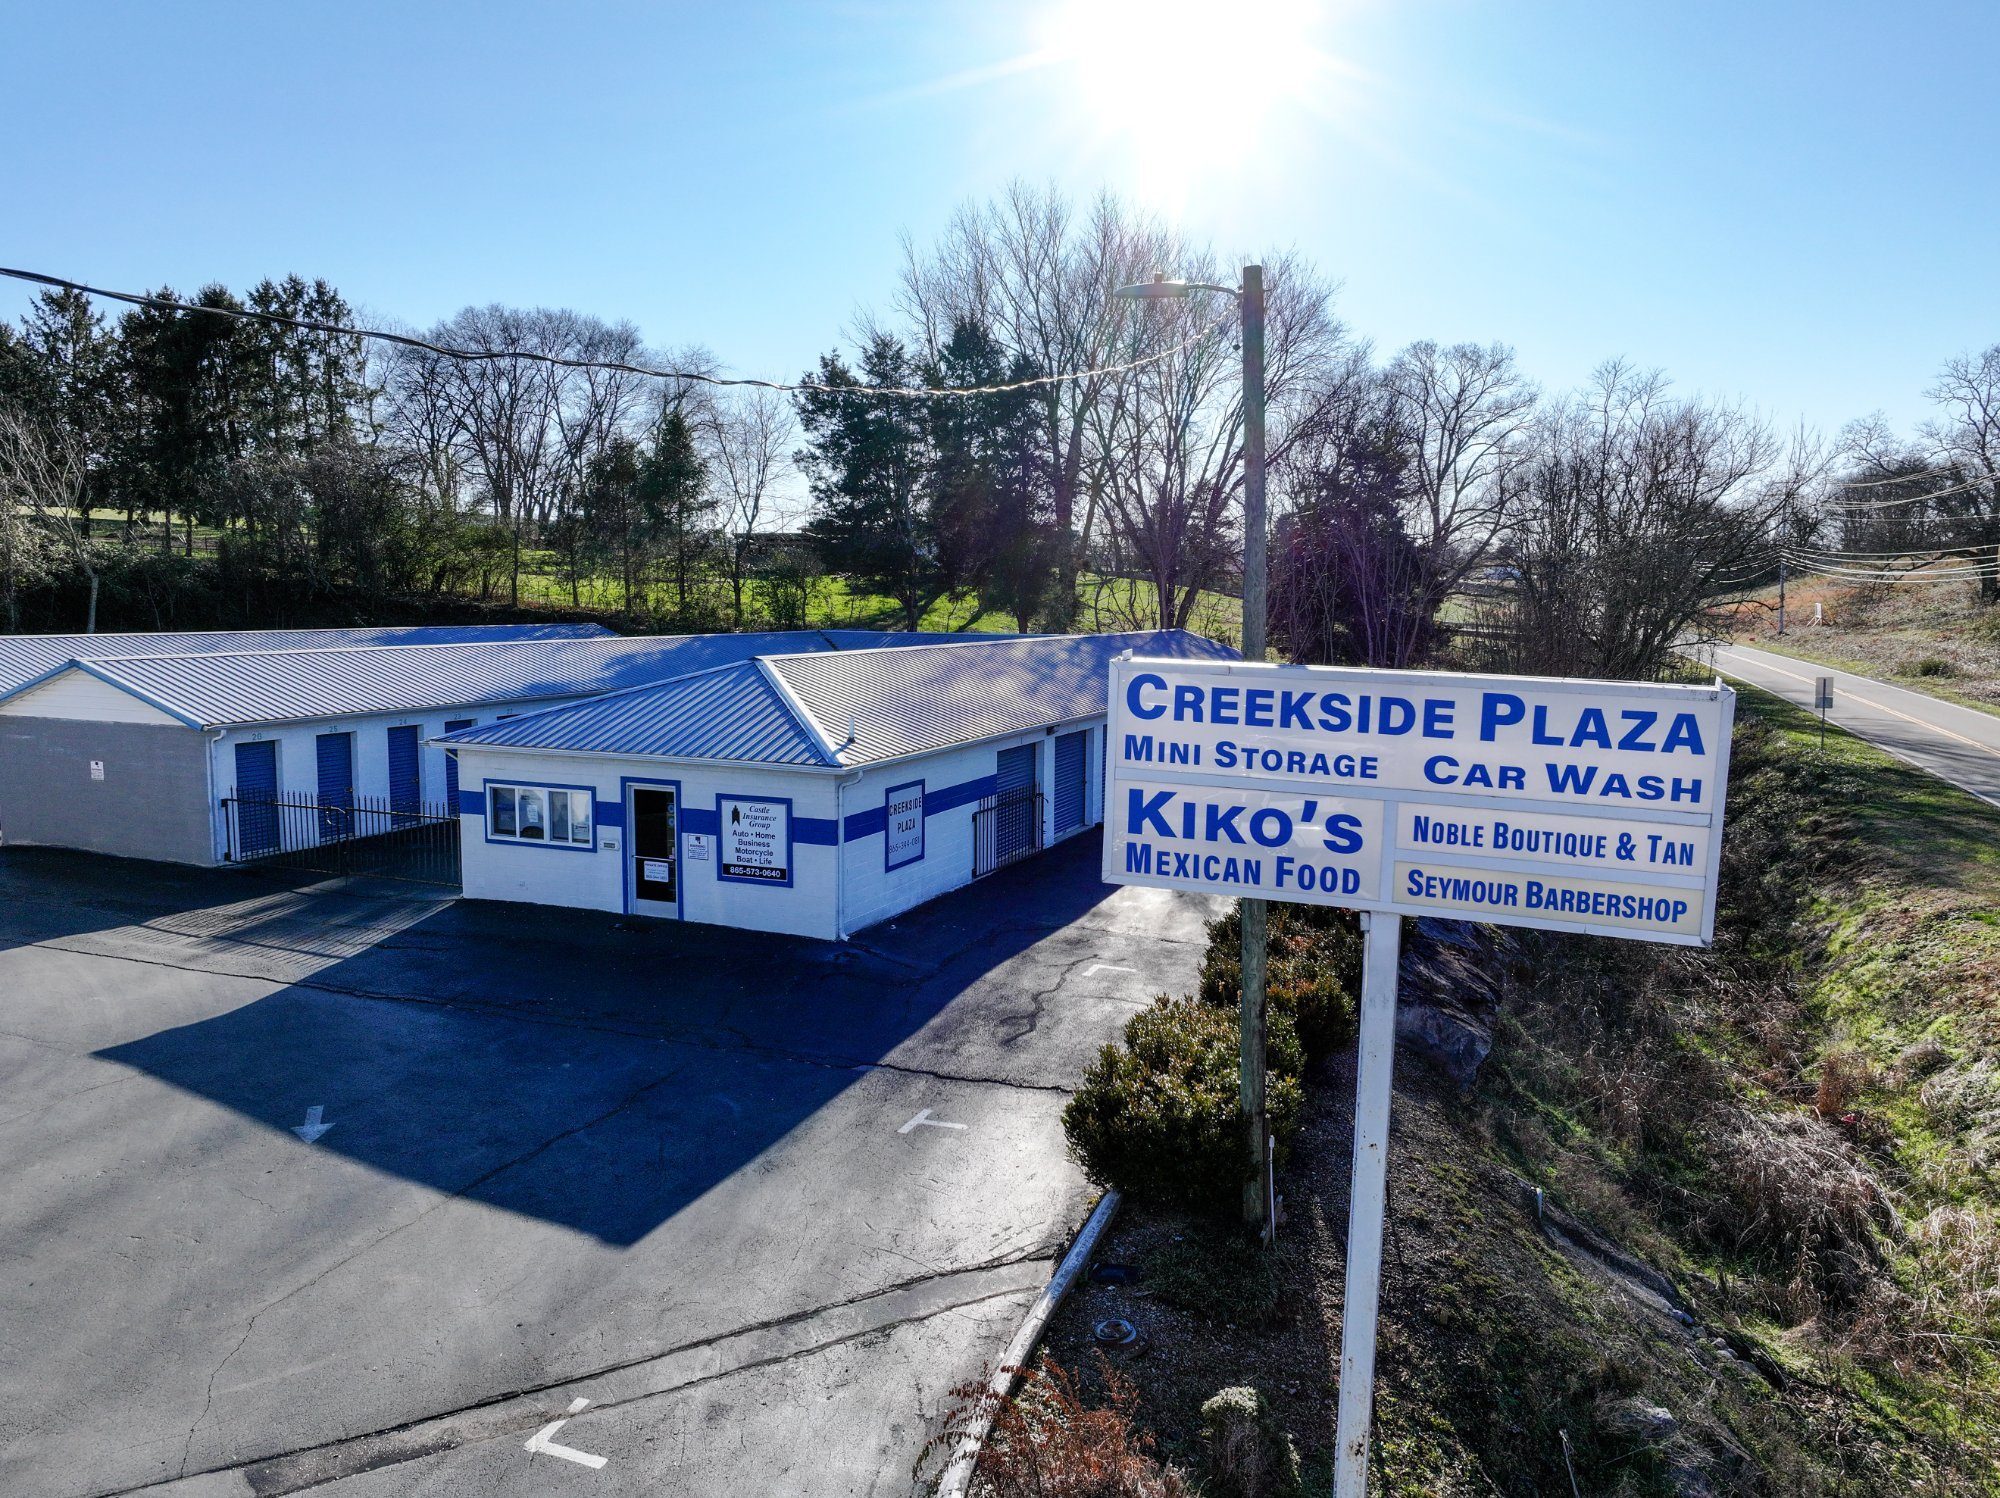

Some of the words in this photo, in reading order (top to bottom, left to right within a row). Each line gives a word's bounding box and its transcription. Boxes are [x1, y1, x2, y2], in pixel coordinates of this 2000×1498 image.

[1127, 674, 1455, 739] CREEKSIDE
[1480, 693, 1705, 755] PLAZA
[1125, 735, 1200, 765] MINI
[1215, 741, 1377, 779] STORAGE
[1424, 755, 1526, 790] CAR
[1546, 764, 1702, 803] WASH
[749, 805, 770, 814] Castle
[889, 796, 922, 817] CREEKSIDE
[742, 812, 777, 822] Insurance
[749, 820, 771, 830] Group
[1128, 789, 1363, 854] KIKO'S
[897, 818, 916, 834] PLAZA
[732, 830, 749, 838] Auto
[755, 831, 776, 840] Home
[1414, 816, 1483, 847] NOBLE
[1493, 822, 1606, 858] BOUTIQUE
[1616, 833, 1636, 862] &
[1648, 835, 1694, 866] TAN
[737, 839, 771, 848] Business
[735, 847, 774, 857] Motorcycle
[736, 856, 753, 864] Boat
[759, 857, 772, 865] Life
[1126, 842, 1261, 885] MEXICAN
[1276, 856, 1360, 894] FOOD
[729, 866, 781, 877] 865-573-0640
[1408, 869, 1518, 906] SEYMOUR
[1526, 881, 1687, 922] BARBERSHOP
